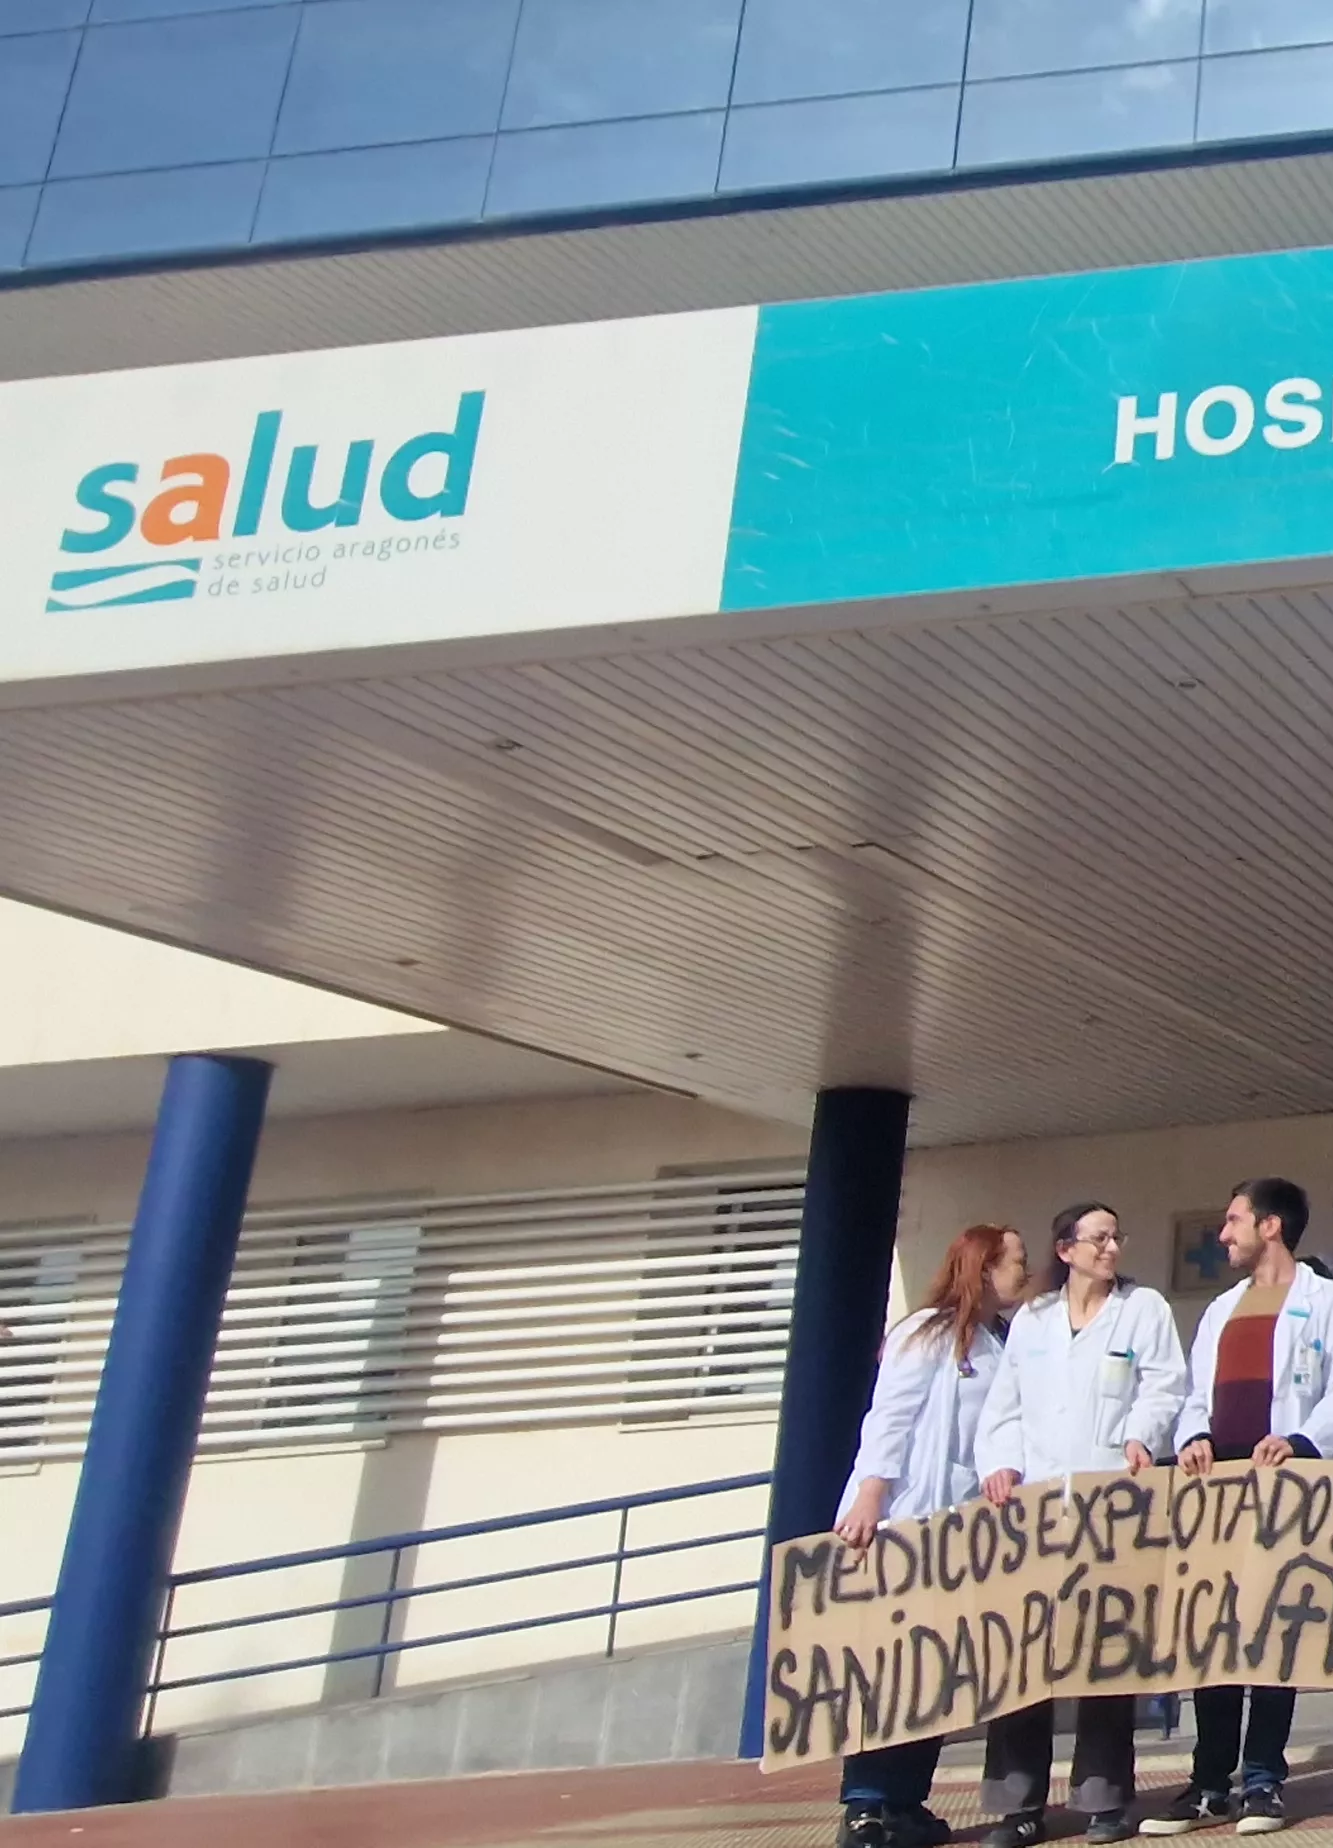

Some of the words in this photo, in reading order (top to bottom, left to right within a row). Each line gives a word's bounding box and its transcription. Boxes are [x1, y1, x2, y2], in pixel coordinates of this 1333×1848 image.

[60, 390, 486, 555] salud
[213, 543, 322, 570] servicio
[332, 528, 461, 562] aragonés
[207, 574, 240, 597] de
[252, 566, 328, 593] salud
